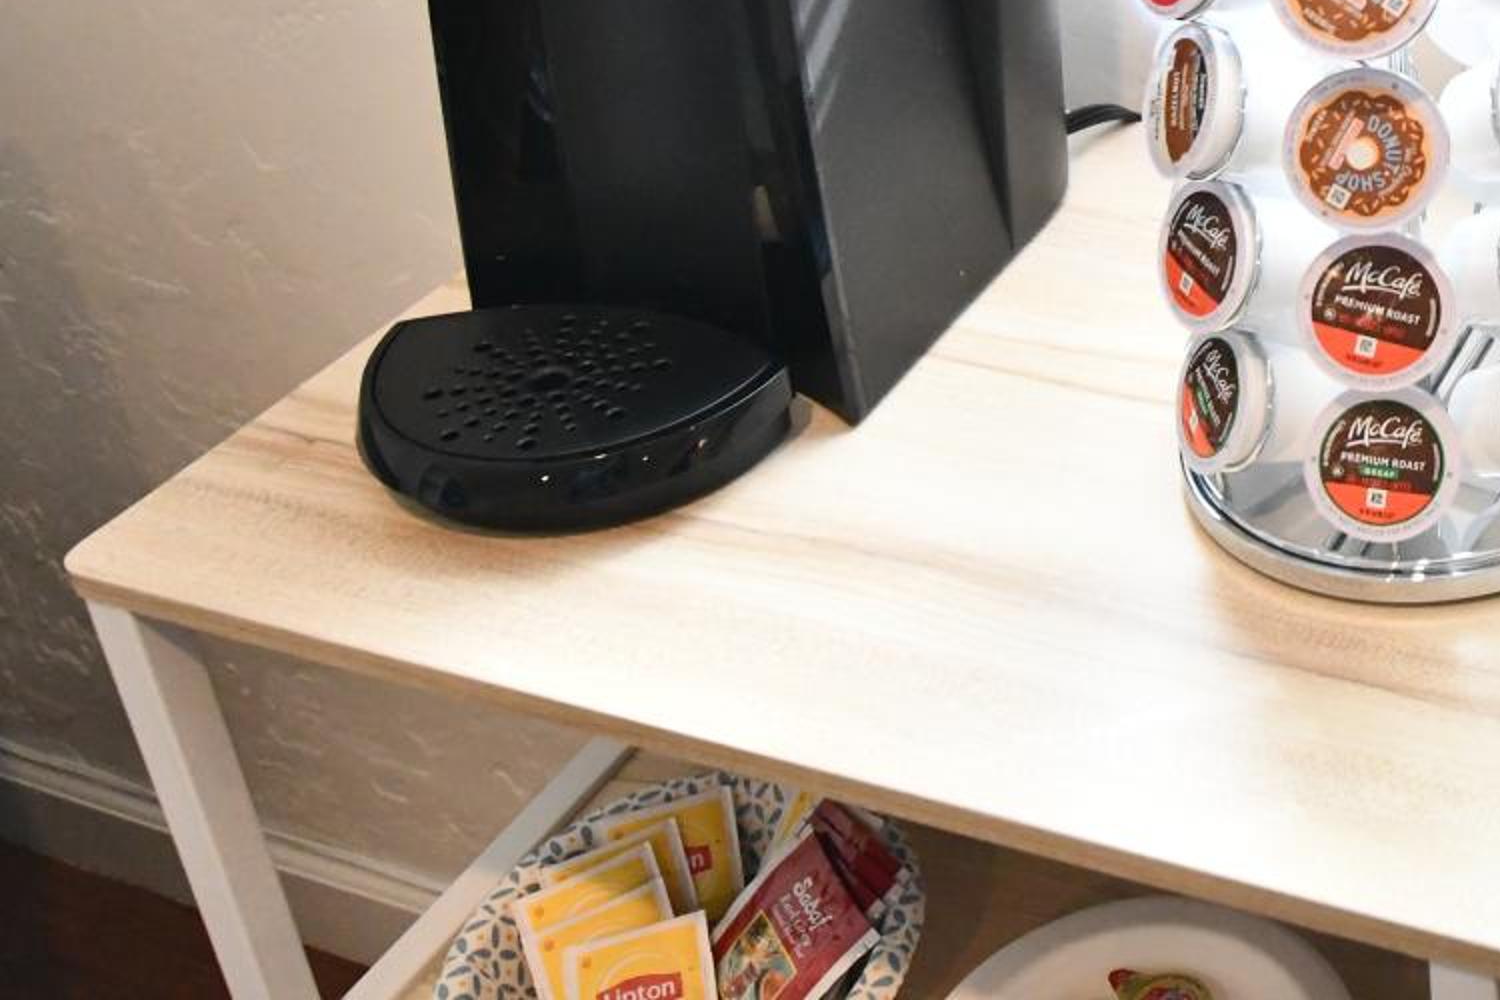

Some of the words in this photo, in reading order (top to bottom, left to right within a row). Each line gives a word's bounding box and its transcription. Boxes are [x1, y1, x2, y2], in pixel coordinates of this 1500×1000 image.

[1335, 172, 1387, 192] SHOP
[1341, 261, 1423, 301] McCafé
[1345, 415, 1424, 449] McCafé
[1340, 451, 1389, 468] PREMIUM
[1391, 457, 1427, 472] ROAST
